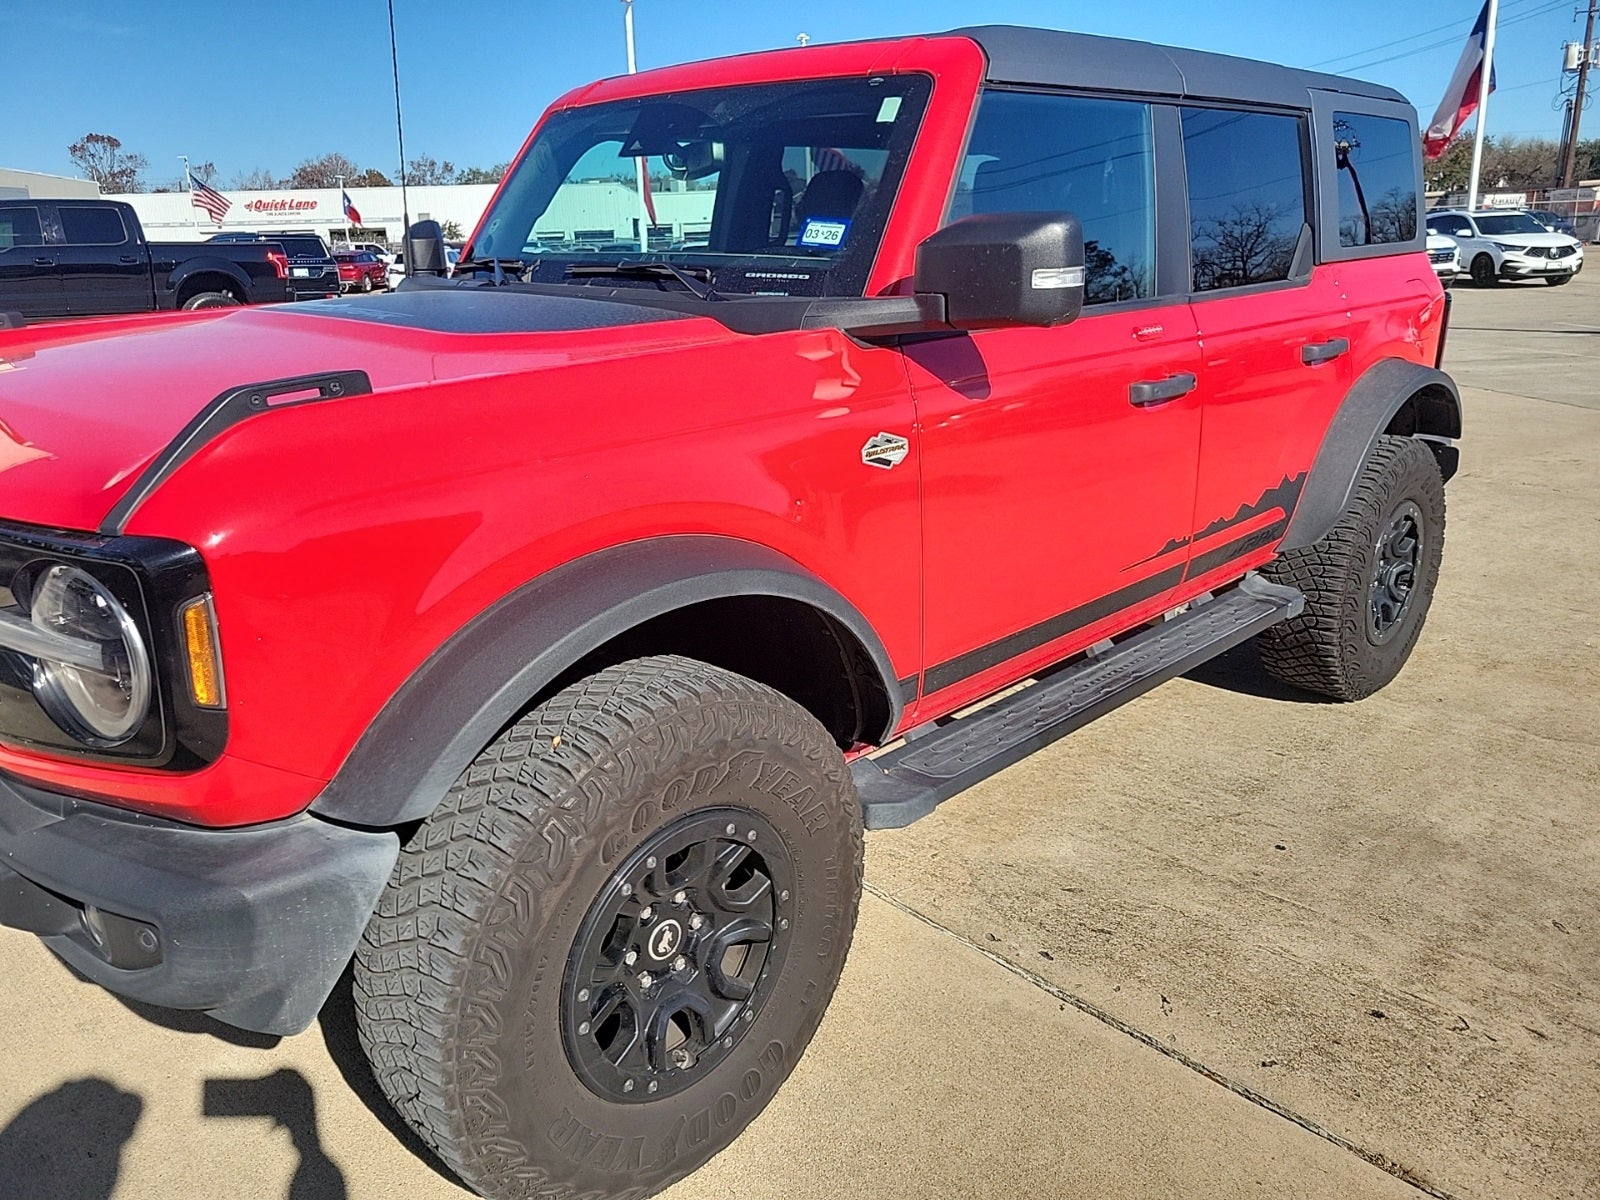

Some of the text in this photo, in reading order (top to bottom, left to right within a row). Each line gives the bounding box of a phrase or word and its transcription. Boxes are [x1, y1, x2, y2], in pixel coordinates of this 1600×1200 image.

[254, 198, 318, 212] Quick Lane
[805, 228, 840, 241] 03 26
[745, 272, 811, 280] BRONCO
[865, 443, 906, 458] WILDTRAK
